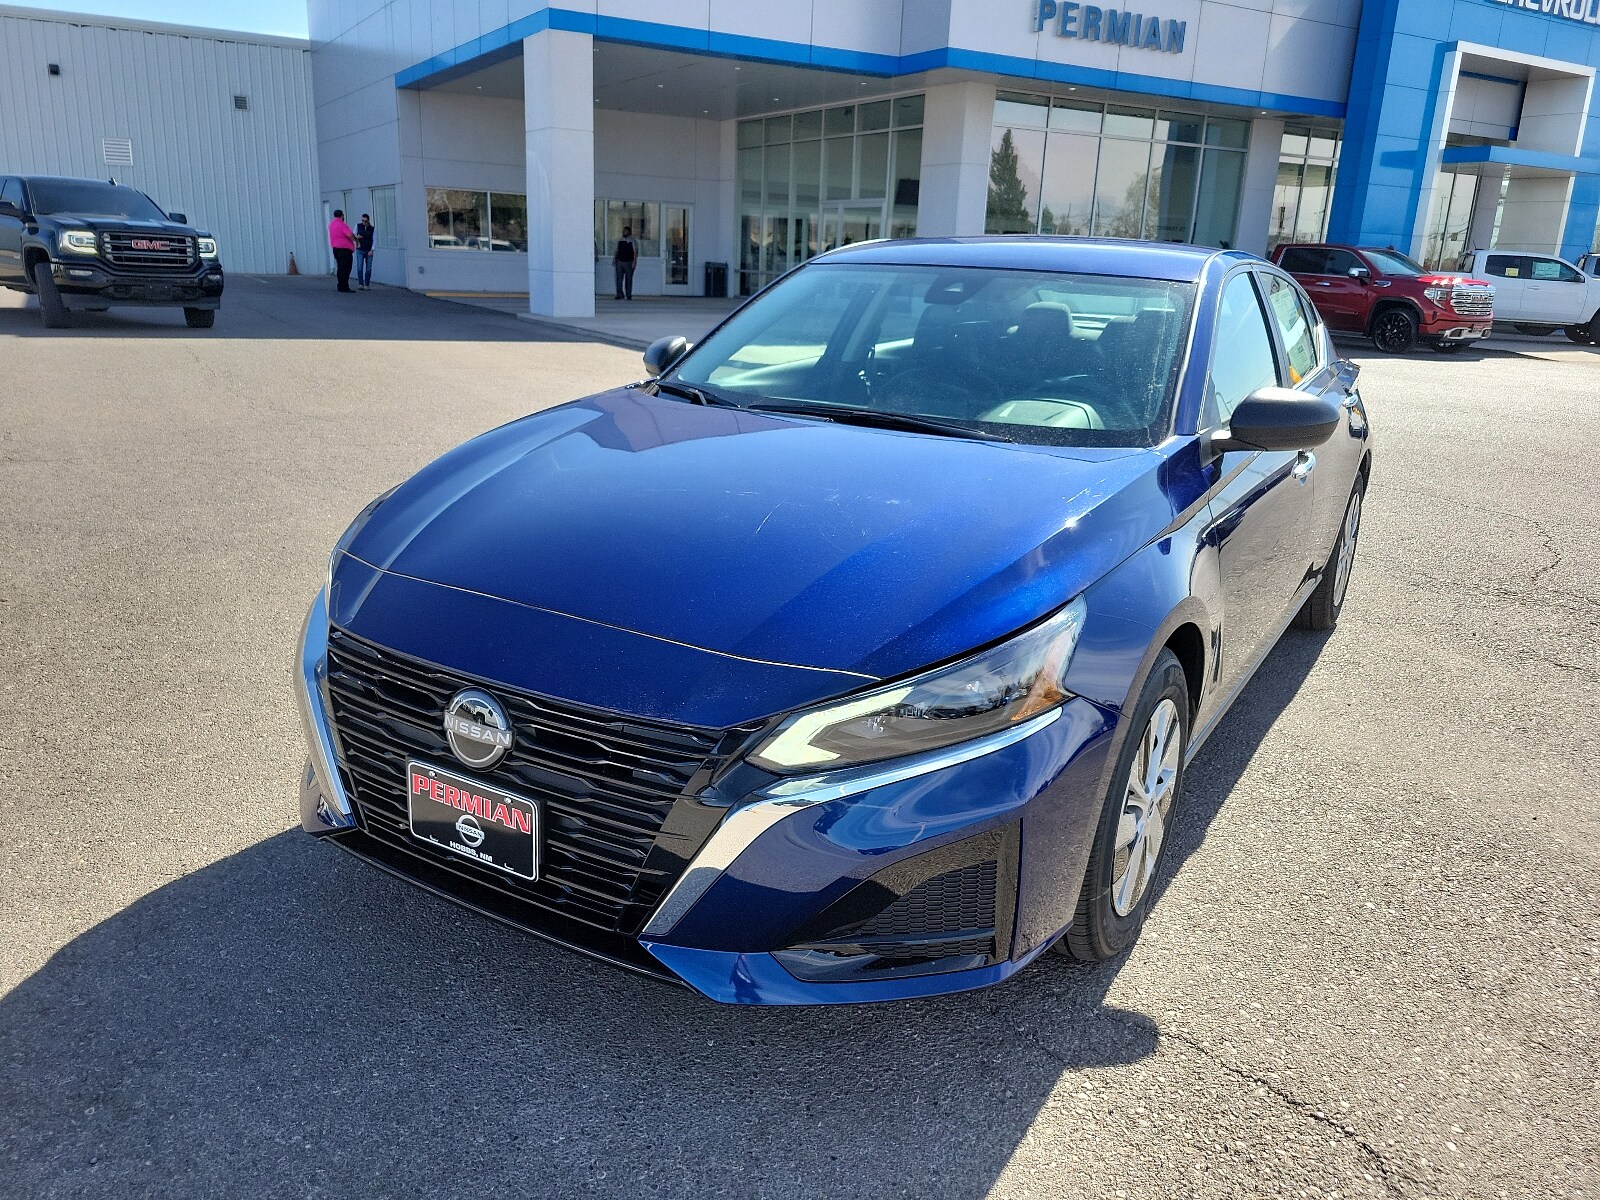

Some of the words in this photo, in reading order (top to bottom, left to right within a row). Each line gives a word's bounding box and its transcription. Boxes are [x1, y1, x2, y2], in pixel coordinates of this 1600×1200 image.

[1034, 0, 1187, 54] PERMIAN
[132, 239, 170, 250] GMC
[444, 713, 510, 745] NISSAN
[412, 772, 532, 834] PERMIAN
[479, 852, 493, 863] NM
